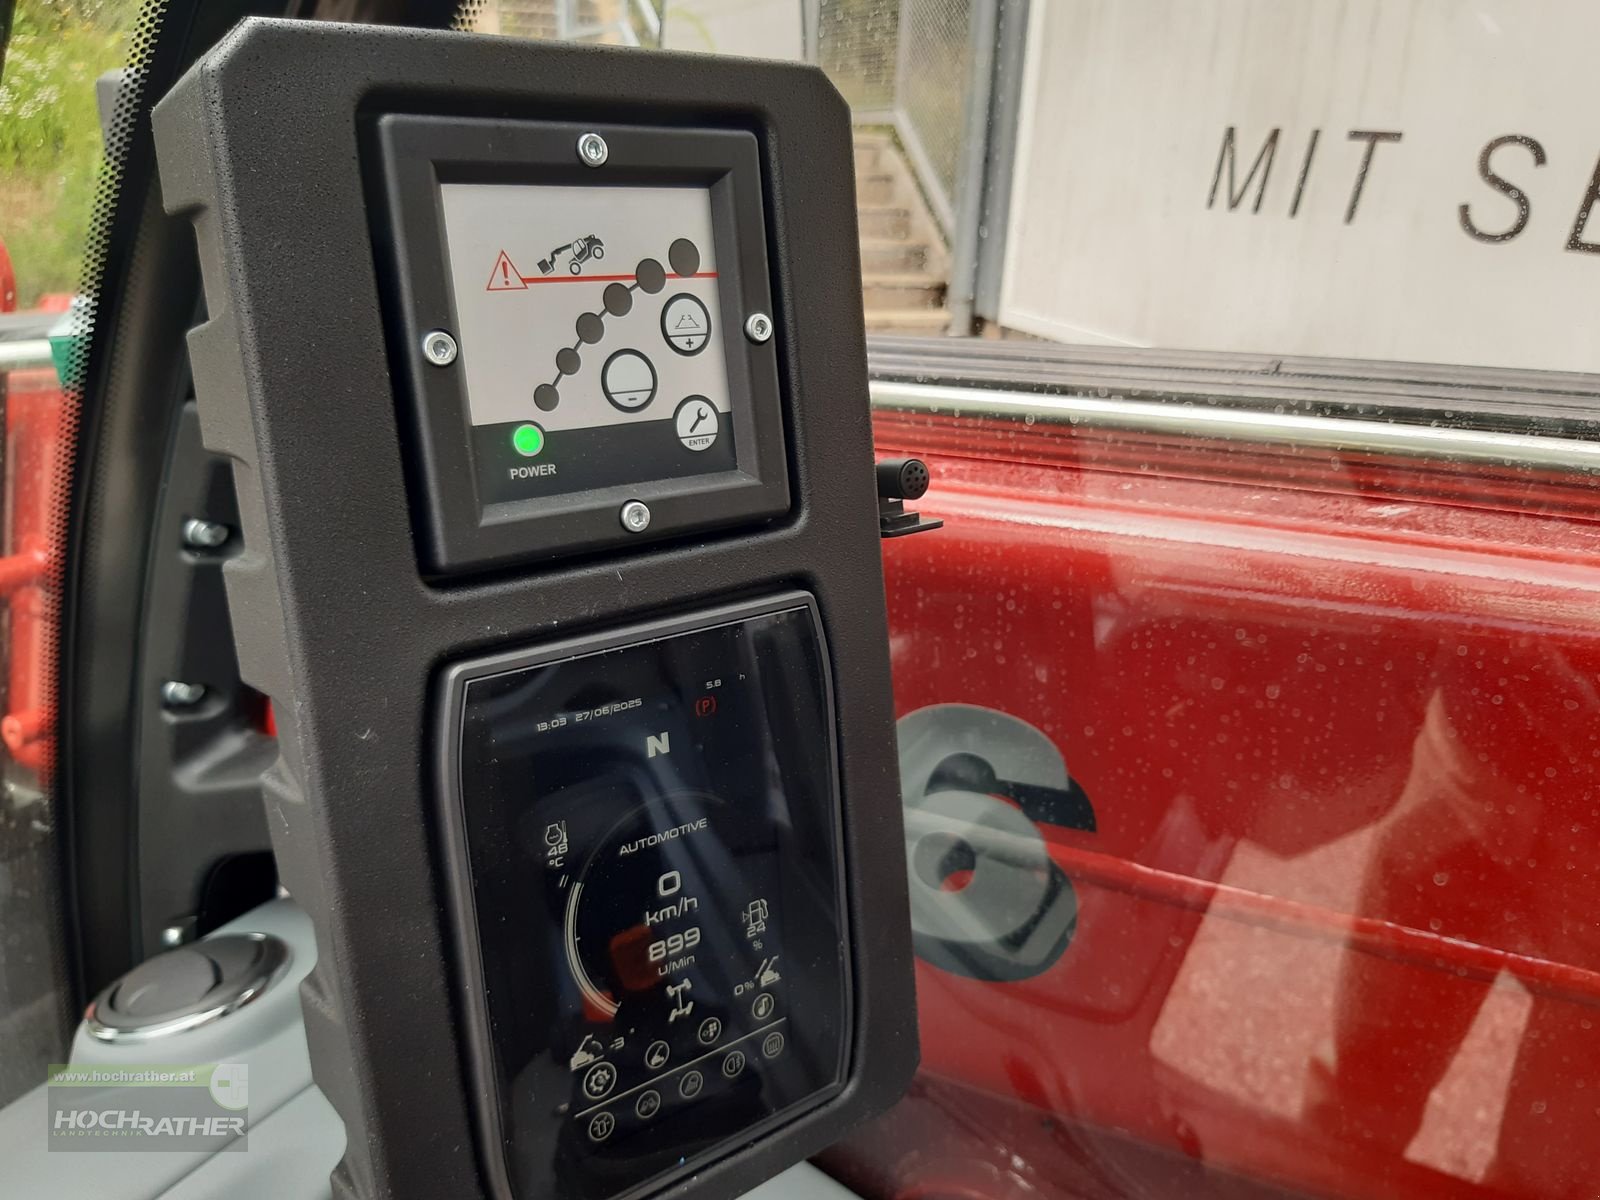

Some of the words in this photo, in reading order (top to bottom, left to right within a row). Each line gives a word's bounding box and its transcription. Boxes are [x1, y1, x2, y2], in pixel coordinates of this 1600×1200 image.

[1206, 126, 1403, 225] MIT
[688, 437, 710, 448] ENTER
[510, 463, 557, 480] POWER
[706, 678, 722, 689] 5.8
[536, 717, 567, 732] 13:03
[575, 698, 643, 723] 27/06/2025
[646, 731, 671, 758] N
[547, 843, 568, 857] 48
[619, 818, 708, 856] AUTOMOTIVE
[658, 870, 682, 896] 0
[645, 897, 698, 926] km/h
[746, 921, 766, 938] 24
[649, 926, 701, 962] 899
